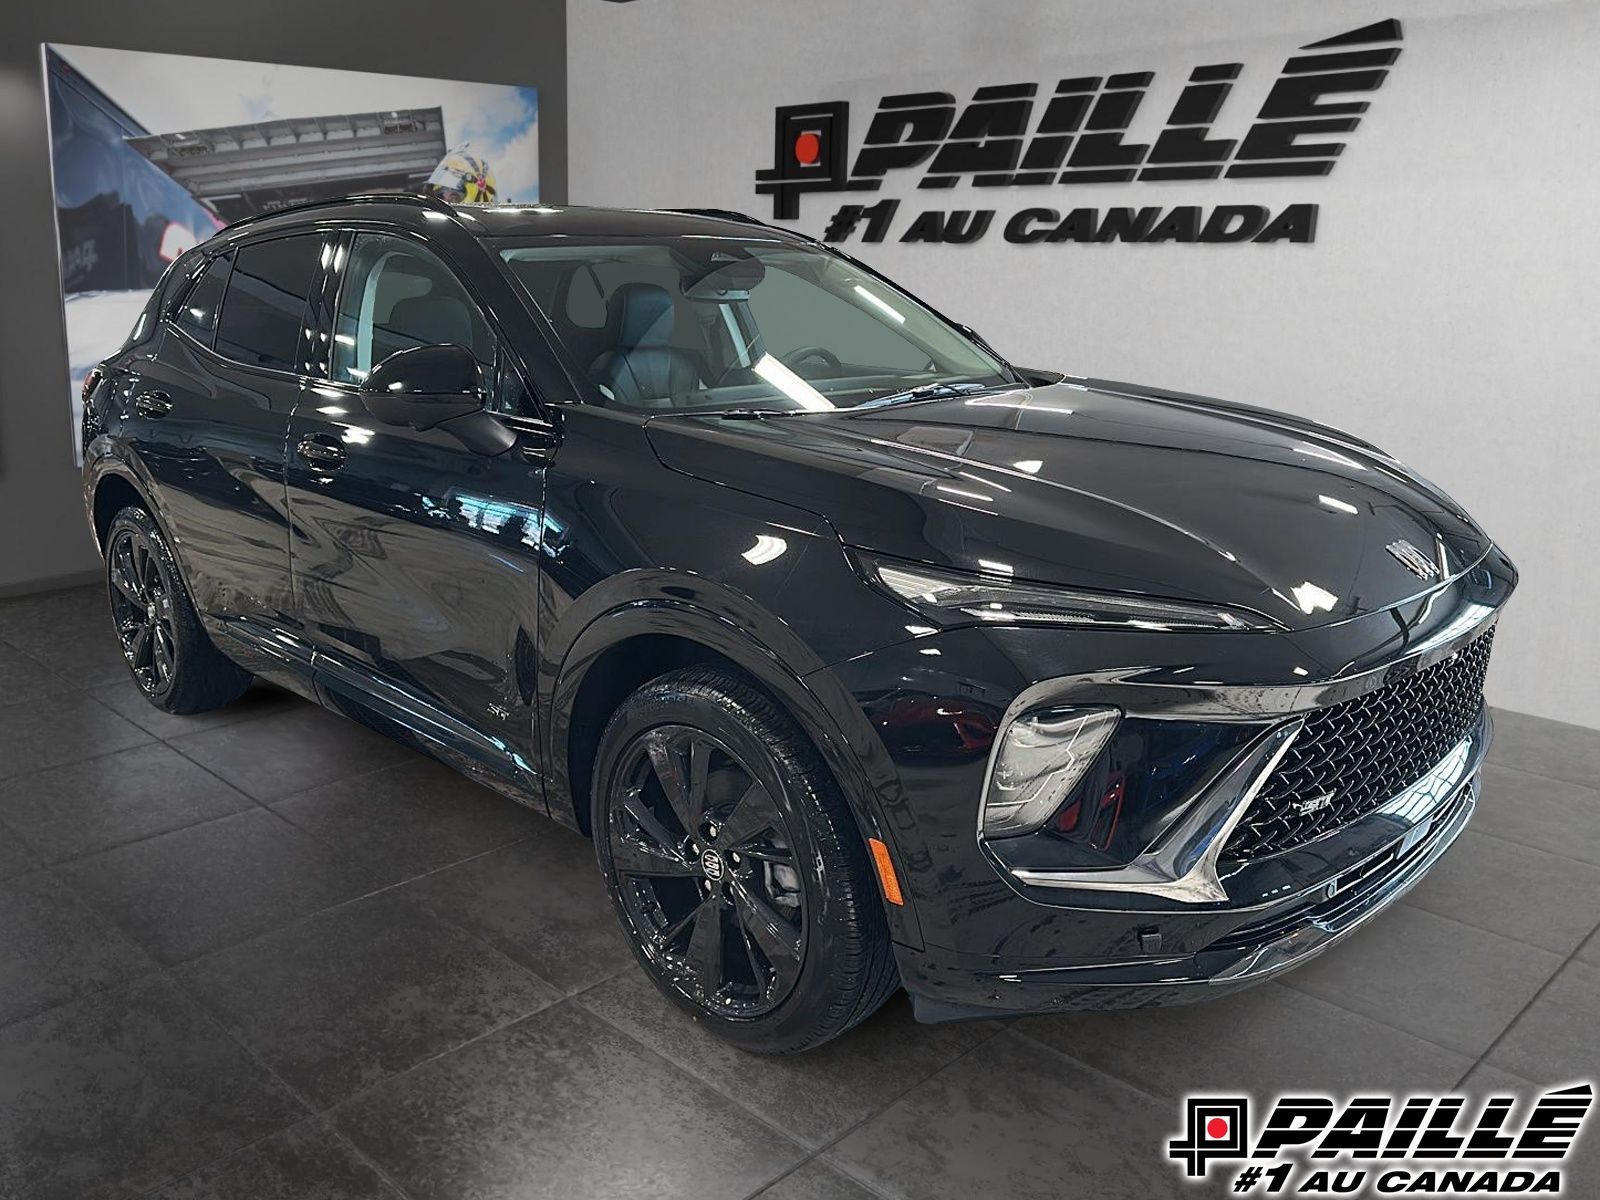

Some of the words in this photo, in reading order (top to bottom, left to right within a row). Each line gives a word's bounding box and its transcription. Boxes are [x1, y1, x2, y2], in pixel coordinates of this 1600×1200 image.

[847, 18, 1403, 191] PAILLÉ
[823, 199, 901, 243] #1
[898, 210, 996, 243] AU
[1003, 204, 1319, 243] CANADA
